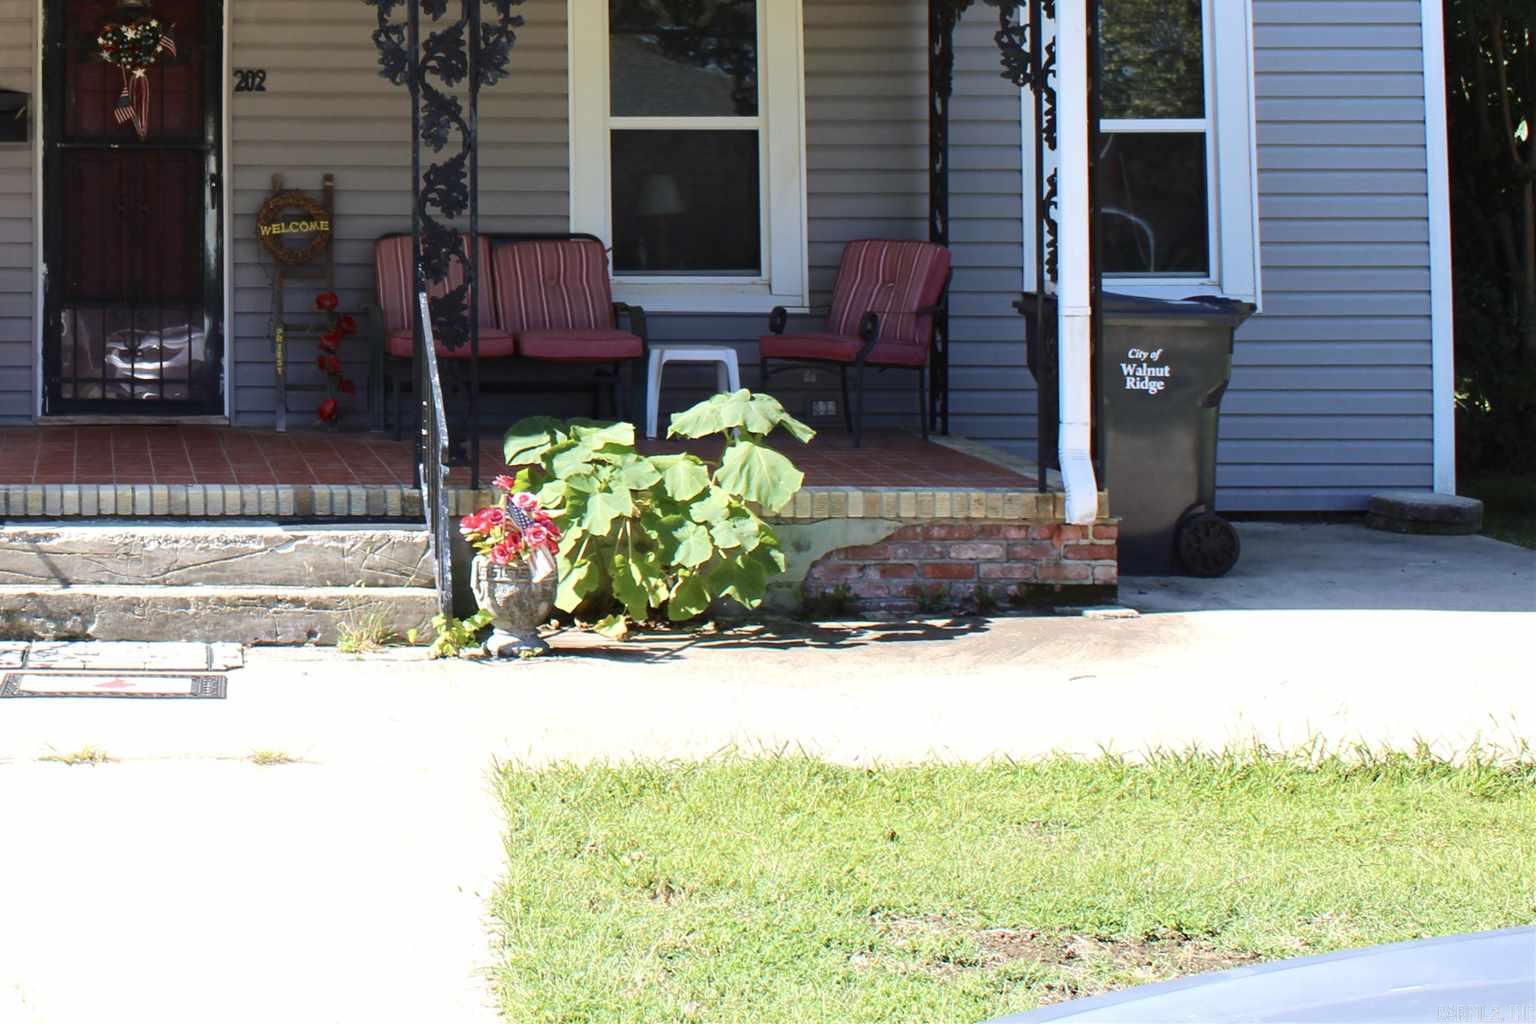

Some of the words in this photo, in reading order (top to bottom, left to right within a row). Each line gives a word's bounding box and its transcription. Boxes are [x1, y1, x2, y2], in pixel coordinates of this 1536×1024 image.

[233, 69, 266, 93] 202
[260, 221, 329, 236] WELCOME
[1128, 348, 1148, 361] City
[1150, 349, 1163, 361] of
[1120, 363, 1170, 377] Walnut
[1125, 377, 1164, 395] Ridge
